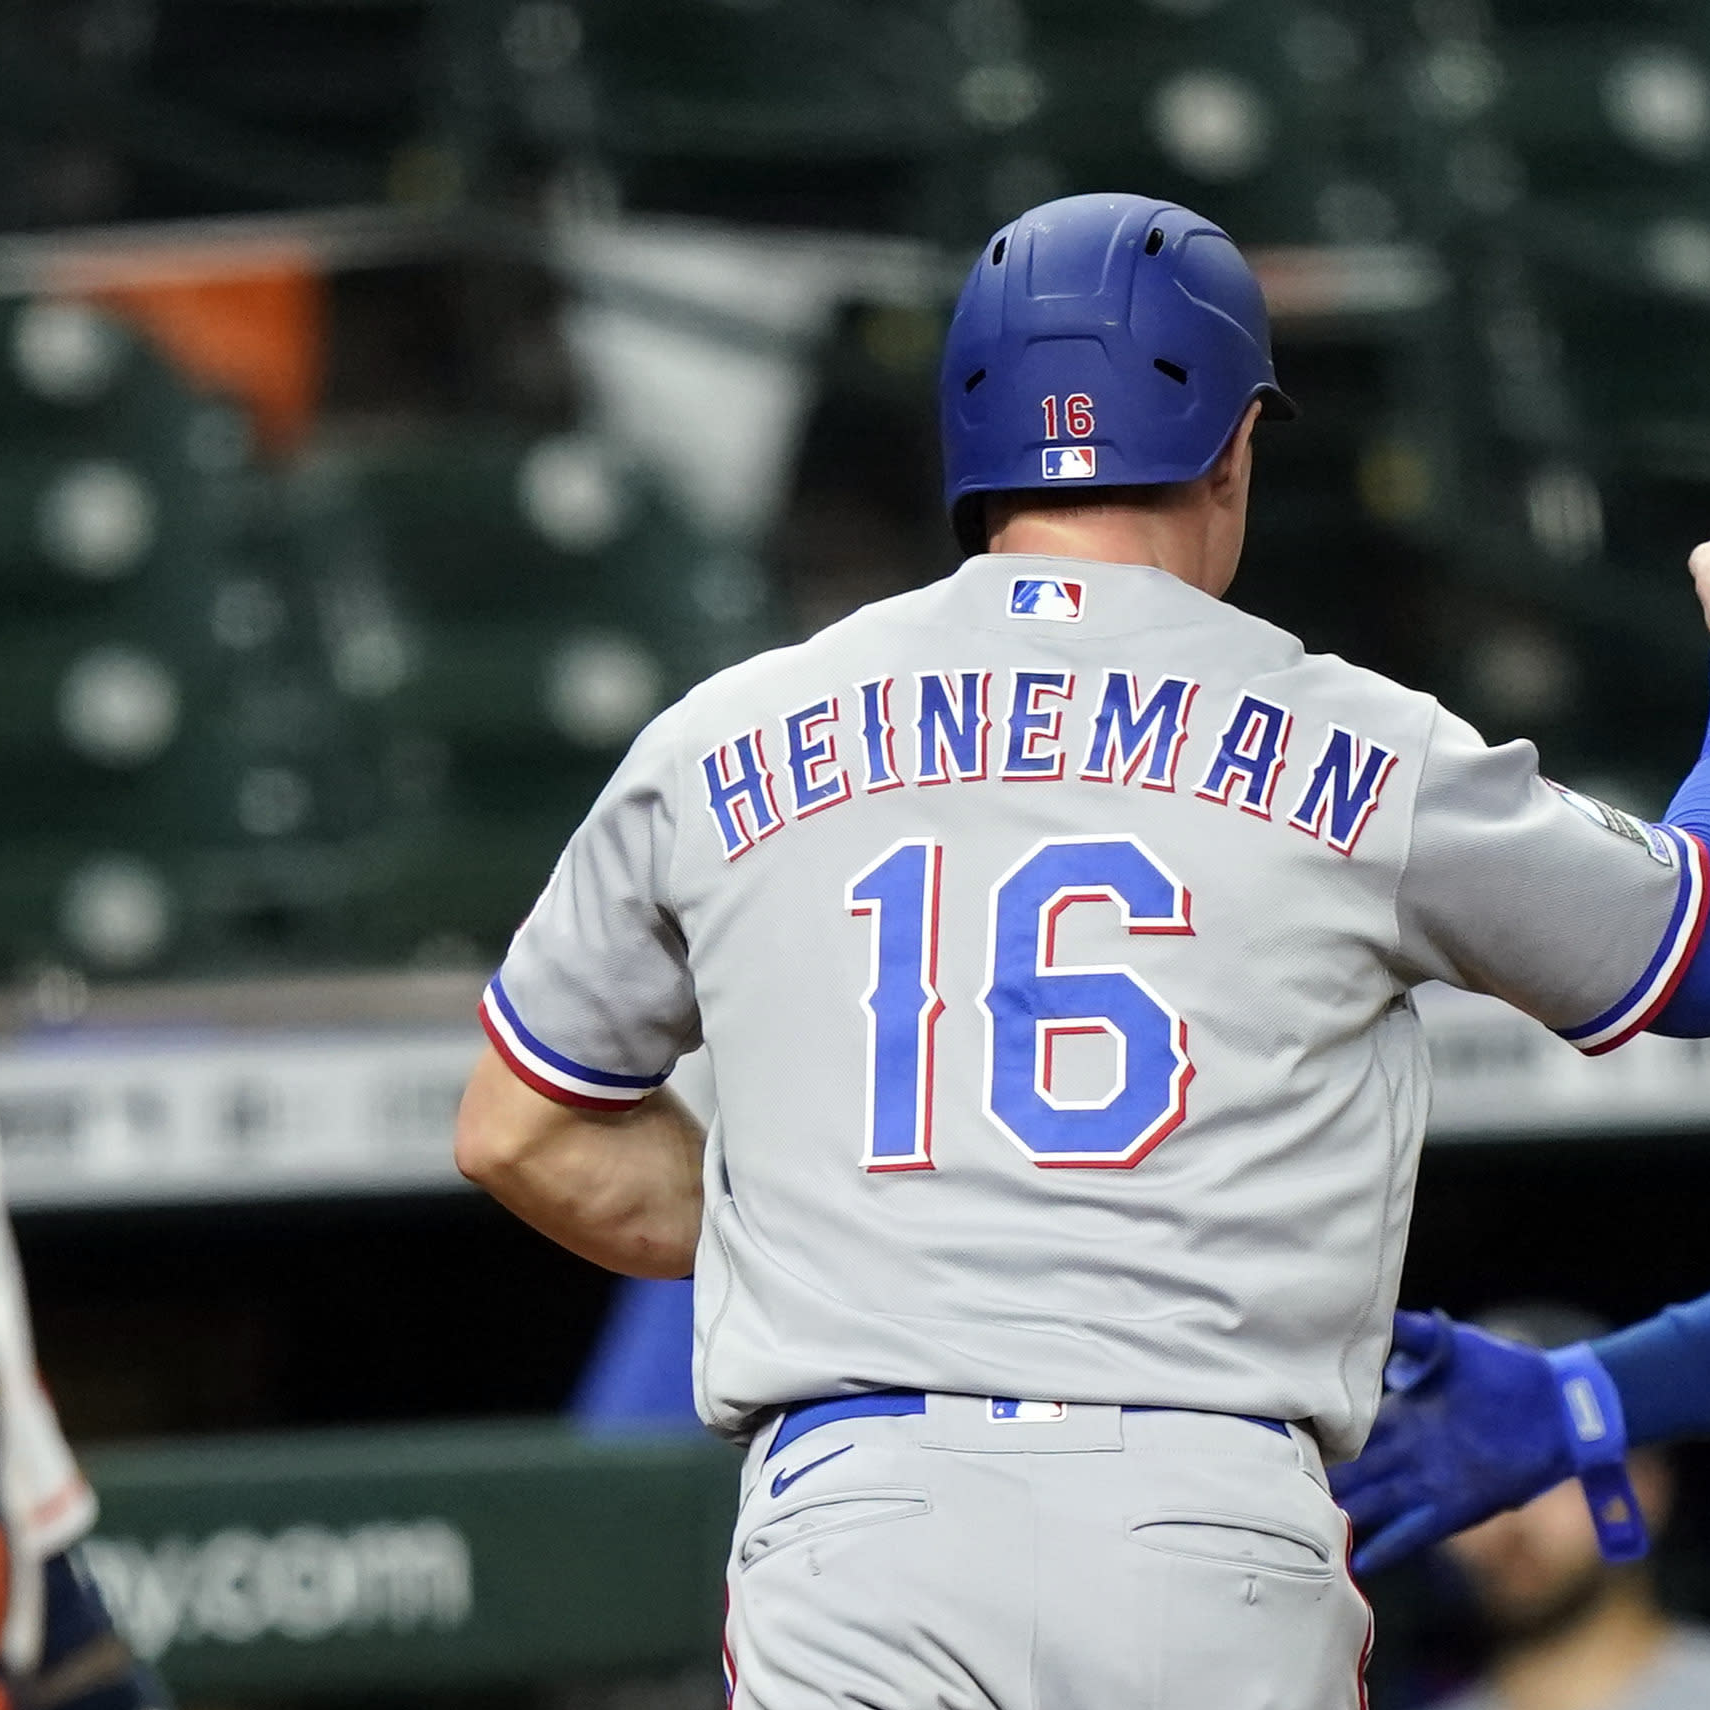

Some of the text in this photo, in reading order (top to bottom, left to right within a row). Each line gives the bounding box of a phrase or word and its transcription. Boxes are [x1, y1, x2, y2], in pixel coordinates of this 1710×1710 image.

[1041, 392, 1095, 439] 16
[698, 666, 1397, 862] HEINEMAN
[845, 833, 1196, 1172] 16
